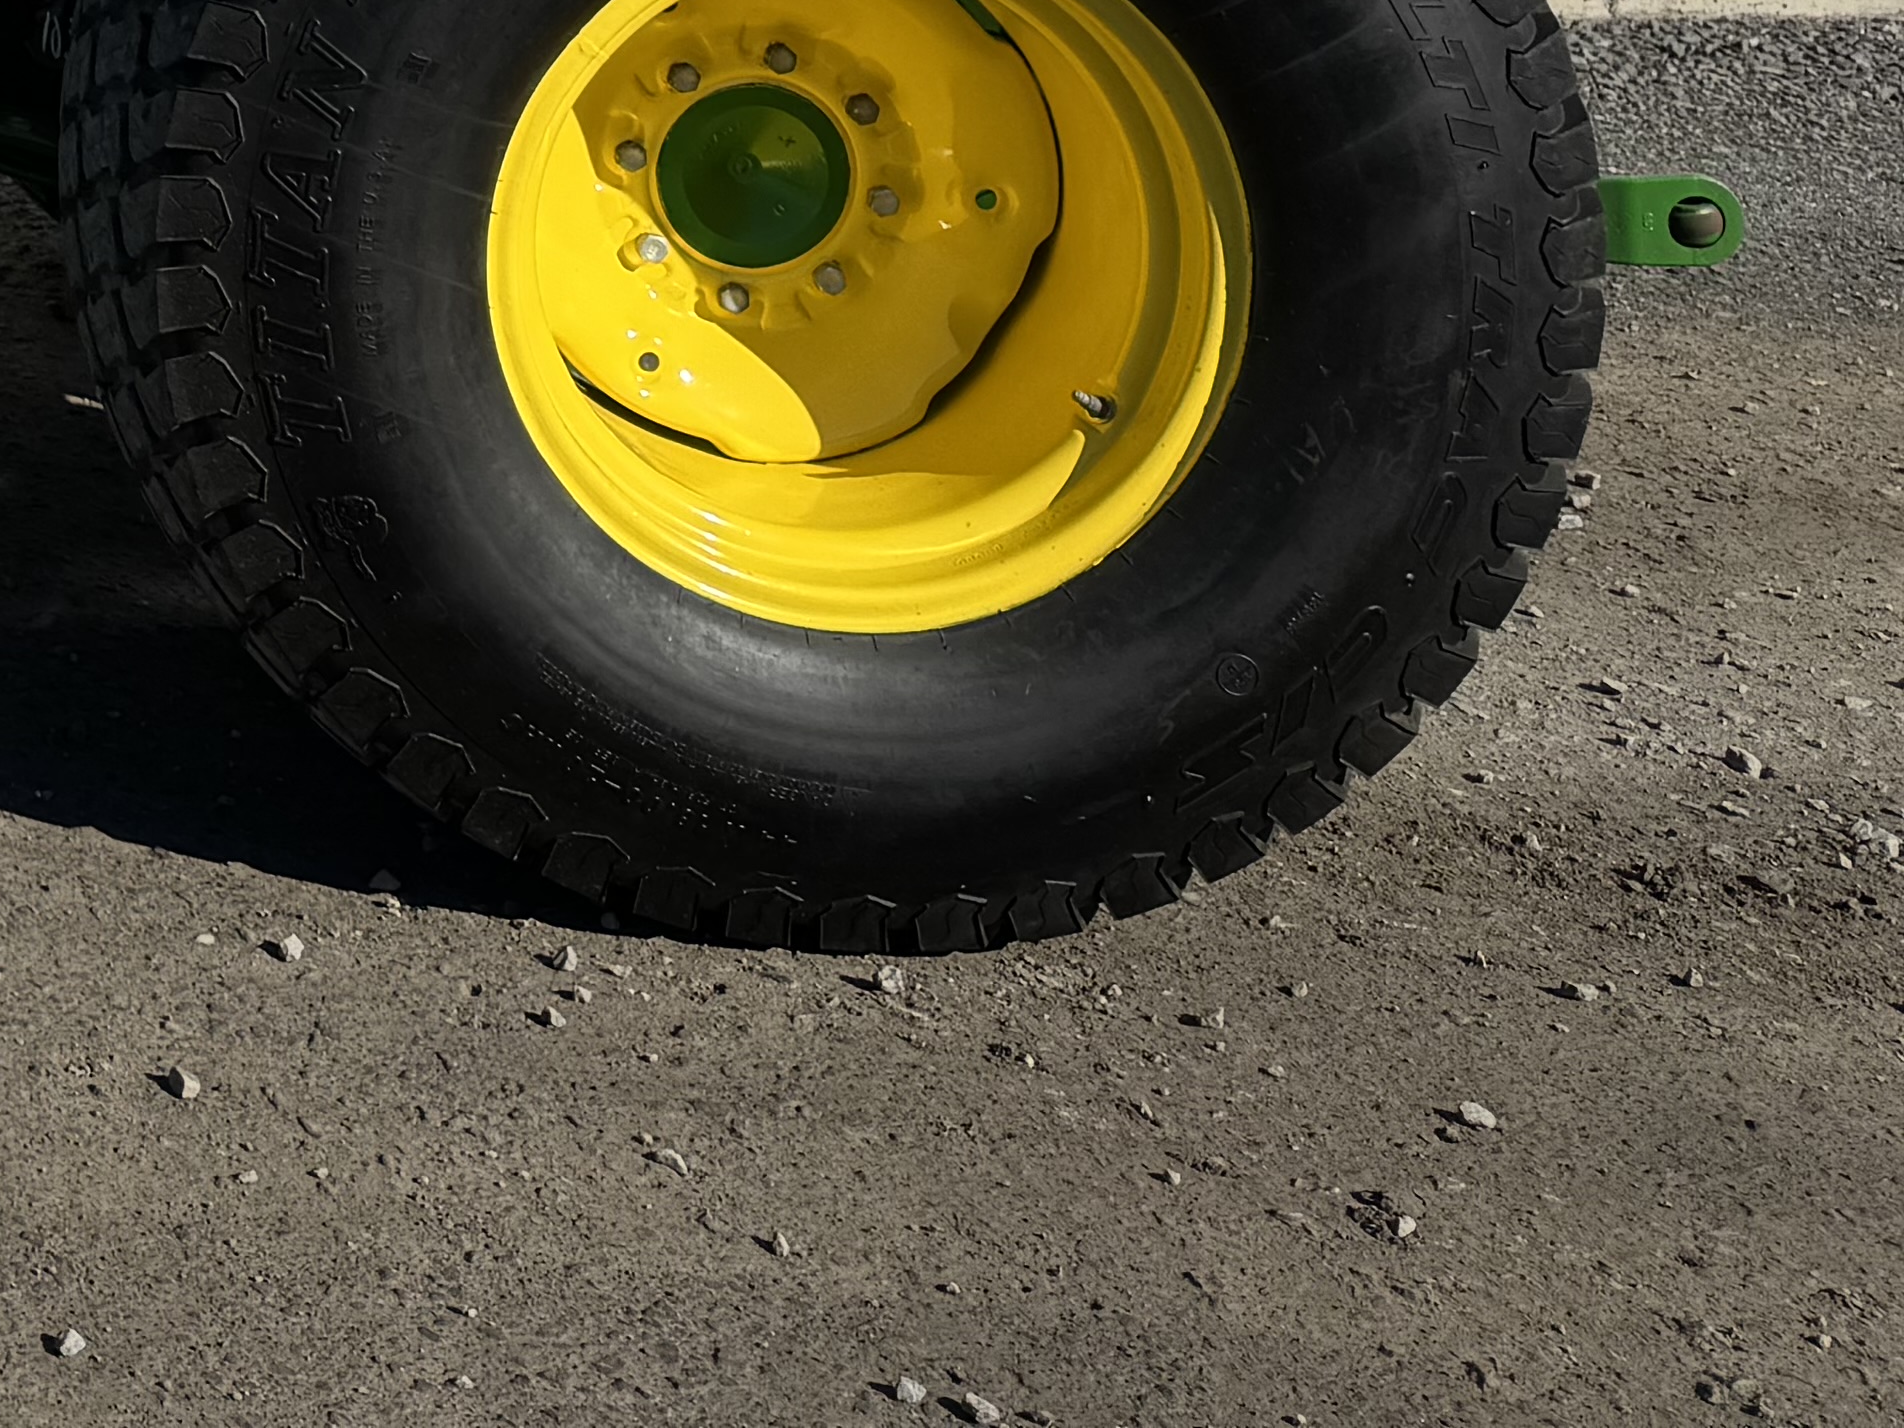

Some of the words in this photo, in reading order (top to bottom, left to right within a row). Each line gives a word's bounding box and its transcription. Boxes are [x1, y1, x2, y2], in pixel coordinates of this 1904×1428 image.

[247, 17, 370, 449] TITAN
[356, 214, 376, 254] THE
[1411, 204, 1516, 576] TRAC
